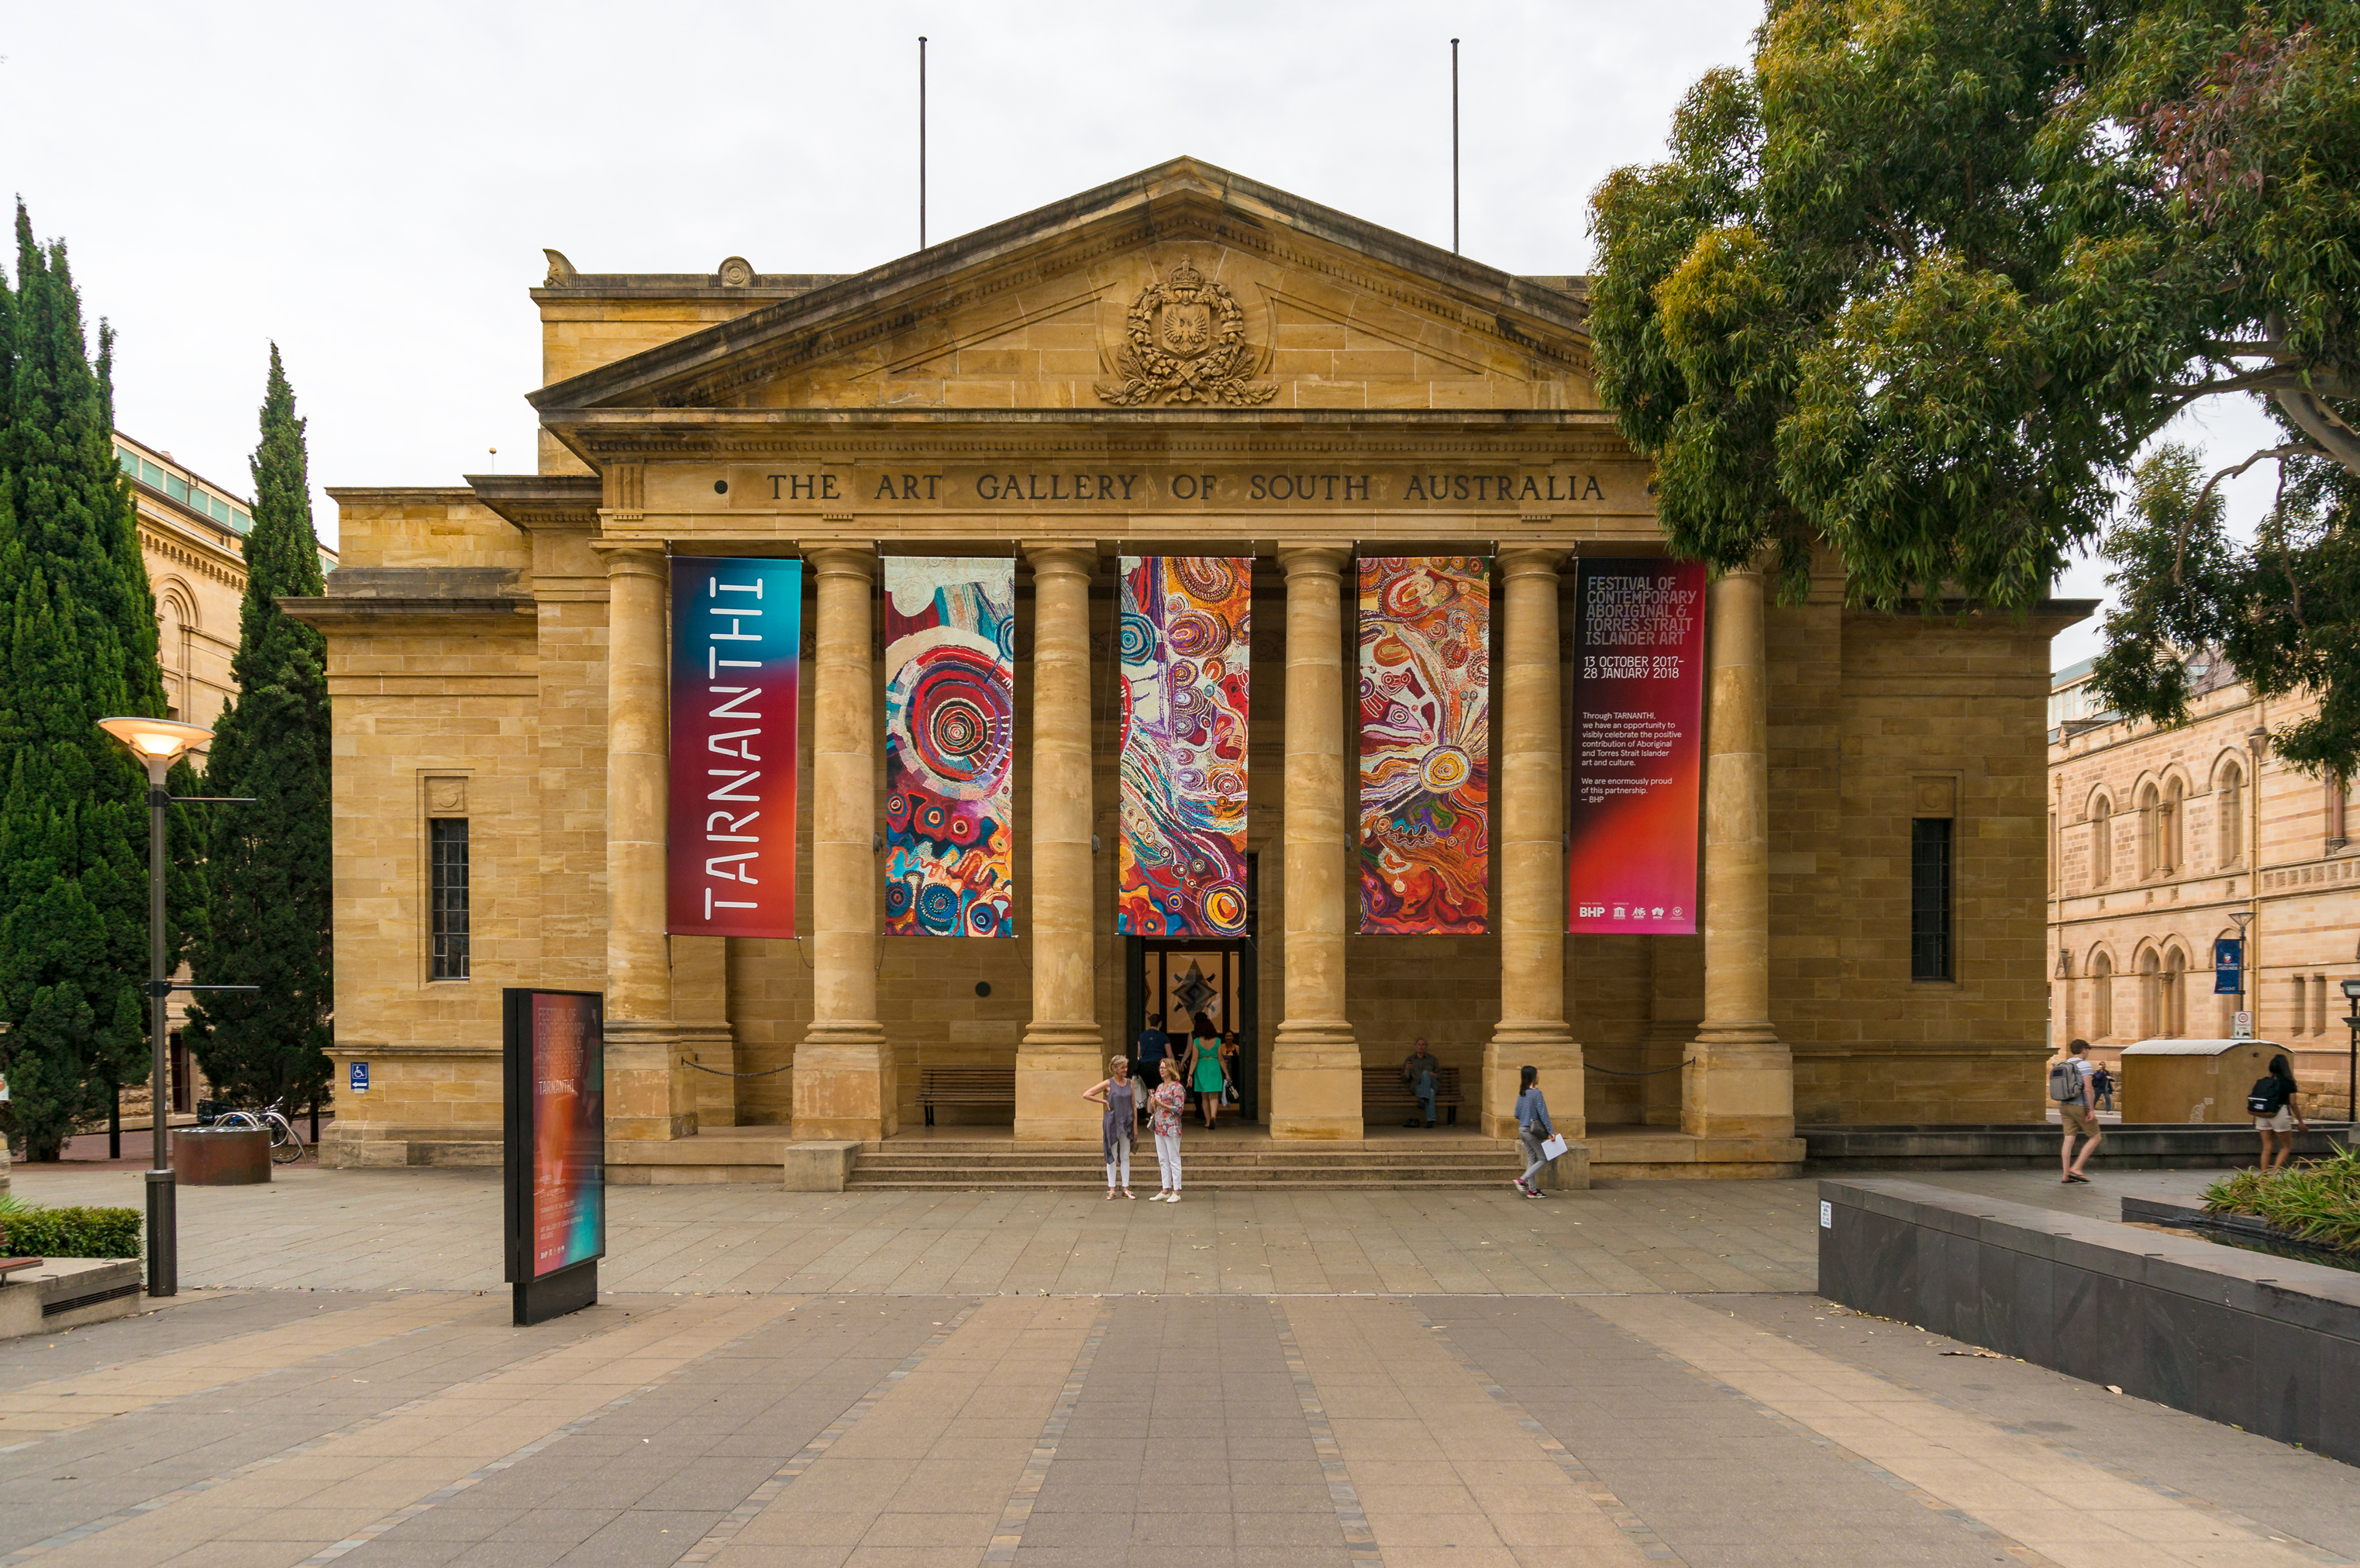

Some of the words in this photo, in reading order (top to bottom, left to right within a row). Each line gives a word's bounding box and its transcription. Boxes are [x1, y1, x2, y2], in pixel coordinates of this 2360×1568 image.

[767, 474, 841, 500] THE
[873, 474, 942, 500] ART
[976, 474, 1138, 500] GALLERY
[1172, 474, 1217, 500] OF
[1250, 474, 1369, 501] SOUTH
[1403, 474, 1605, 501] AUSTRALIA
[1588, 577, 1654, 591] FESTIVAL
[1658, 577, 1676, 591] OF
[1587, 591, 1697, 604] CONTEMPORARY
[1587, 605, 1673, 618] ABORIGINAL
[1676, 605, 1687, 618] &
[1586, 618, 1639, 632] TORRES
[1644, 618, 1693, 632] STRAIT
[1586, 632, 1655, 645] ISLANDER
[1659, 632, 1686, 645] ART
[1584, 656, 1595, 667] 13
[1599, 656, 1649, 667] OCTOBER
[1584, 667, 1597, 679] 28
[1600, 667, 1649, 679] JANUARY
[1653, 667, 1680, 679] 2018
[1583, 712, 1612, 721] Through
[705, 576, 763, 921] TARNANTHI
[1637, 740, 1672, 749] Aboriginal
[1605, 787, 1648, 795] partnership.
[1580, 907, 1605, 918] BHP
[539, 1008, 567, 1022] FESTIVAL
[569, 1008, 576, 1021] OF
[538, 1022, 585, 1036] CONTEMPORARY
[539, 1036, 576, 1050] ABORIGINAL
[539, 1050, 563, 1065] TORRES
[563, 1049, 584, 1064] STRAIT
[539, 1064, 570, 1080] ISLANDER
[570, 1064, 581, 1077] ART
[539, 1079, 574, 1095] TARNANTHI
